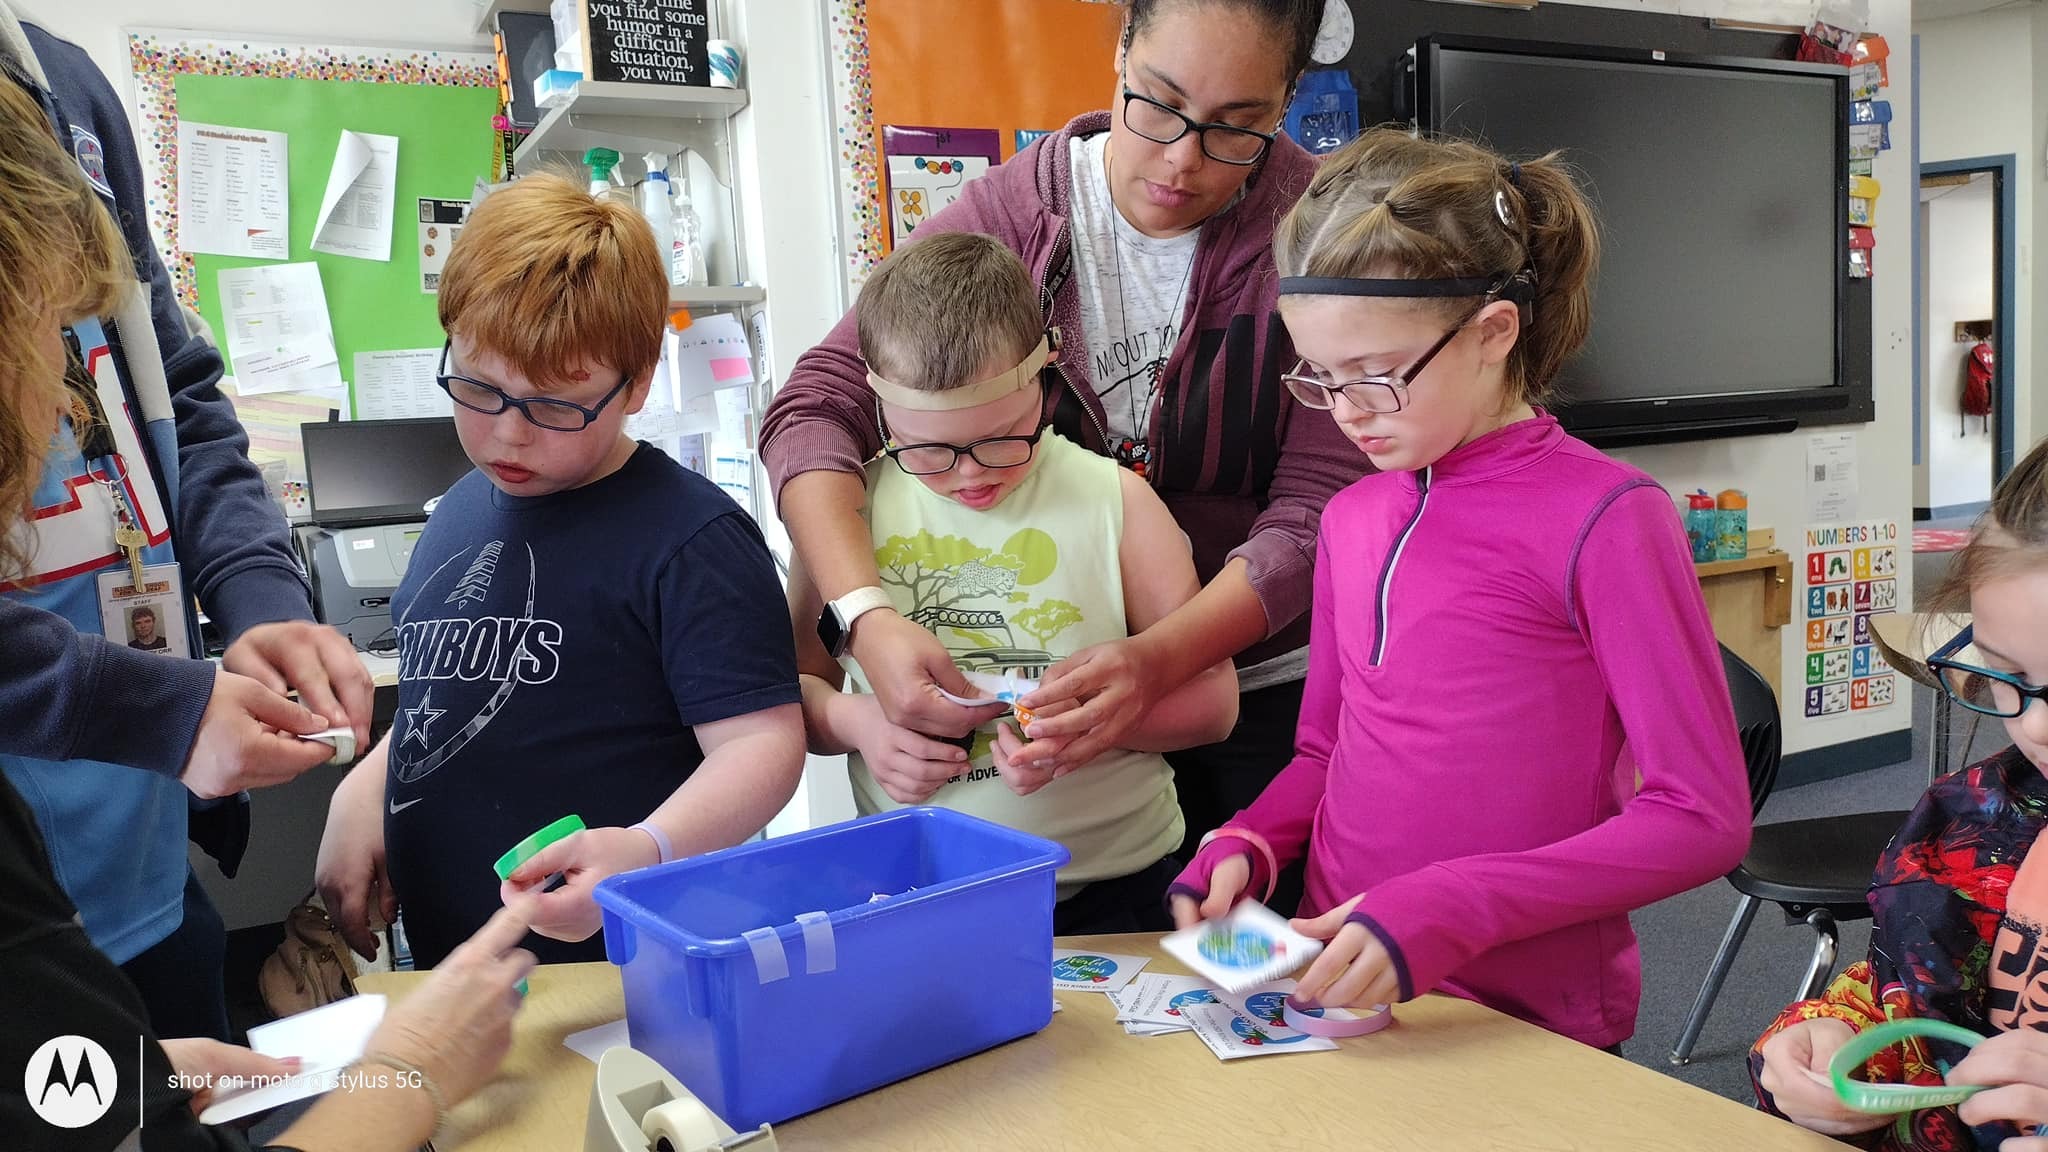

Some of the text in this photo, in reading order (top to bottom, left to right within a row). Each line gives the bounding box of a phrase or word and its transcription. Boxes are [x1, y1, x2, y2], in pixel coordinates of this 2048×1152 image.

[590, 3, 705, 25] you find some
[606, 16, 693, 39] humor in a
[614, 32, 688, 54] difficult
[610, 48, 694, 72] situation,
[621, 66, 687, 83] you win
[1132, 444, 1147, 459] ABC
[1807, 523, 1896, 547] NUMBERS 1-10
[1812, 555, 1819, 573] 1
[1858, 551, 1866, 568] 6
[1812, 589, 1821, 607] 2
[1858, 583, 1867, 601] 7
[1812, 623, 1821, 640] 3
[1858, 615, 1867, 633] 8
[1811, 657, 1819, 673] 4
[1856, 649, 1864, 666] 9
[1810, 689, 1819, 706] 5
[1853, 682, 1867, 699] 10
